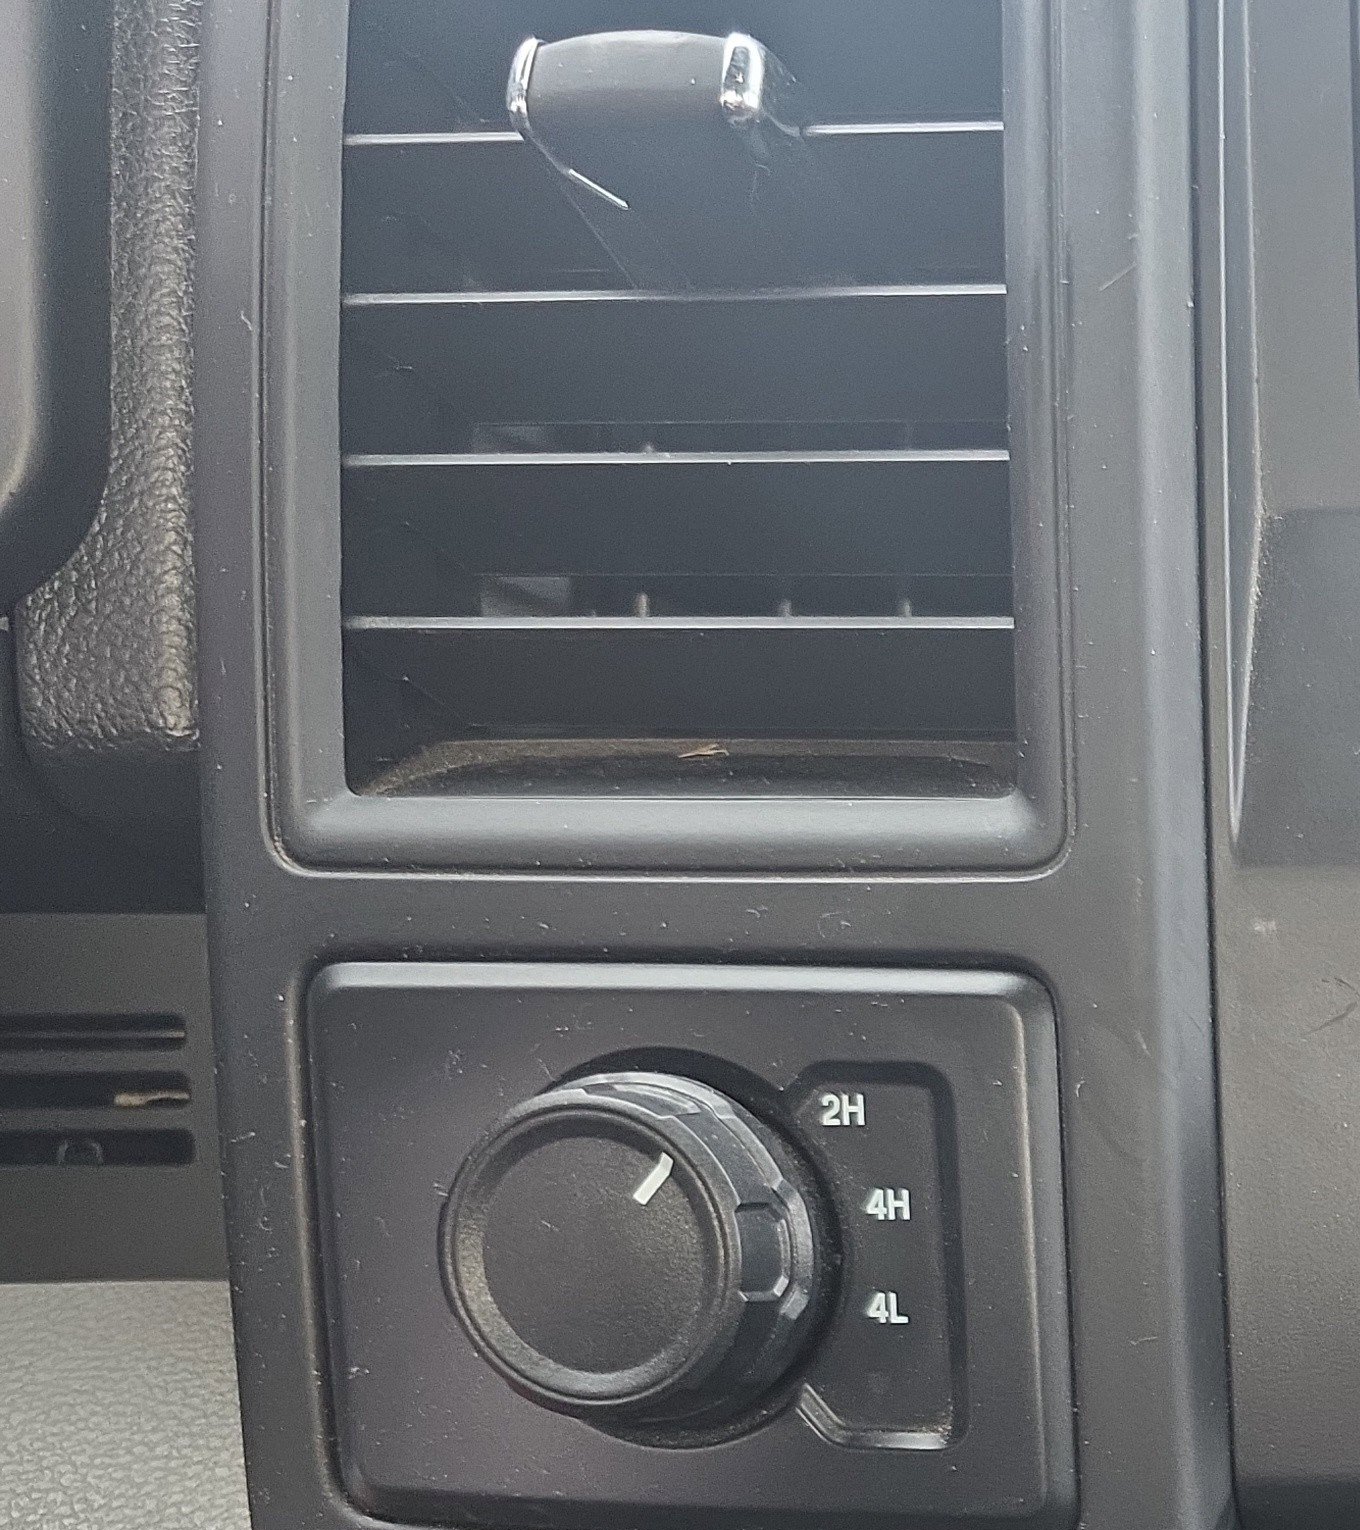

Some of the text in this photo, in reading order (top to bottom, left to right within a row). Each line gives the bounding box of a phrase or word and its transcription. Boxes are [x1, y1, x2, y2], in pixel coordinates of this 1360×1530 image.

[820, 1094, 866, 1126] 2H
[865, 1190, 911, 1221] 4H
[867, 1293, 909, 1325] 4L
